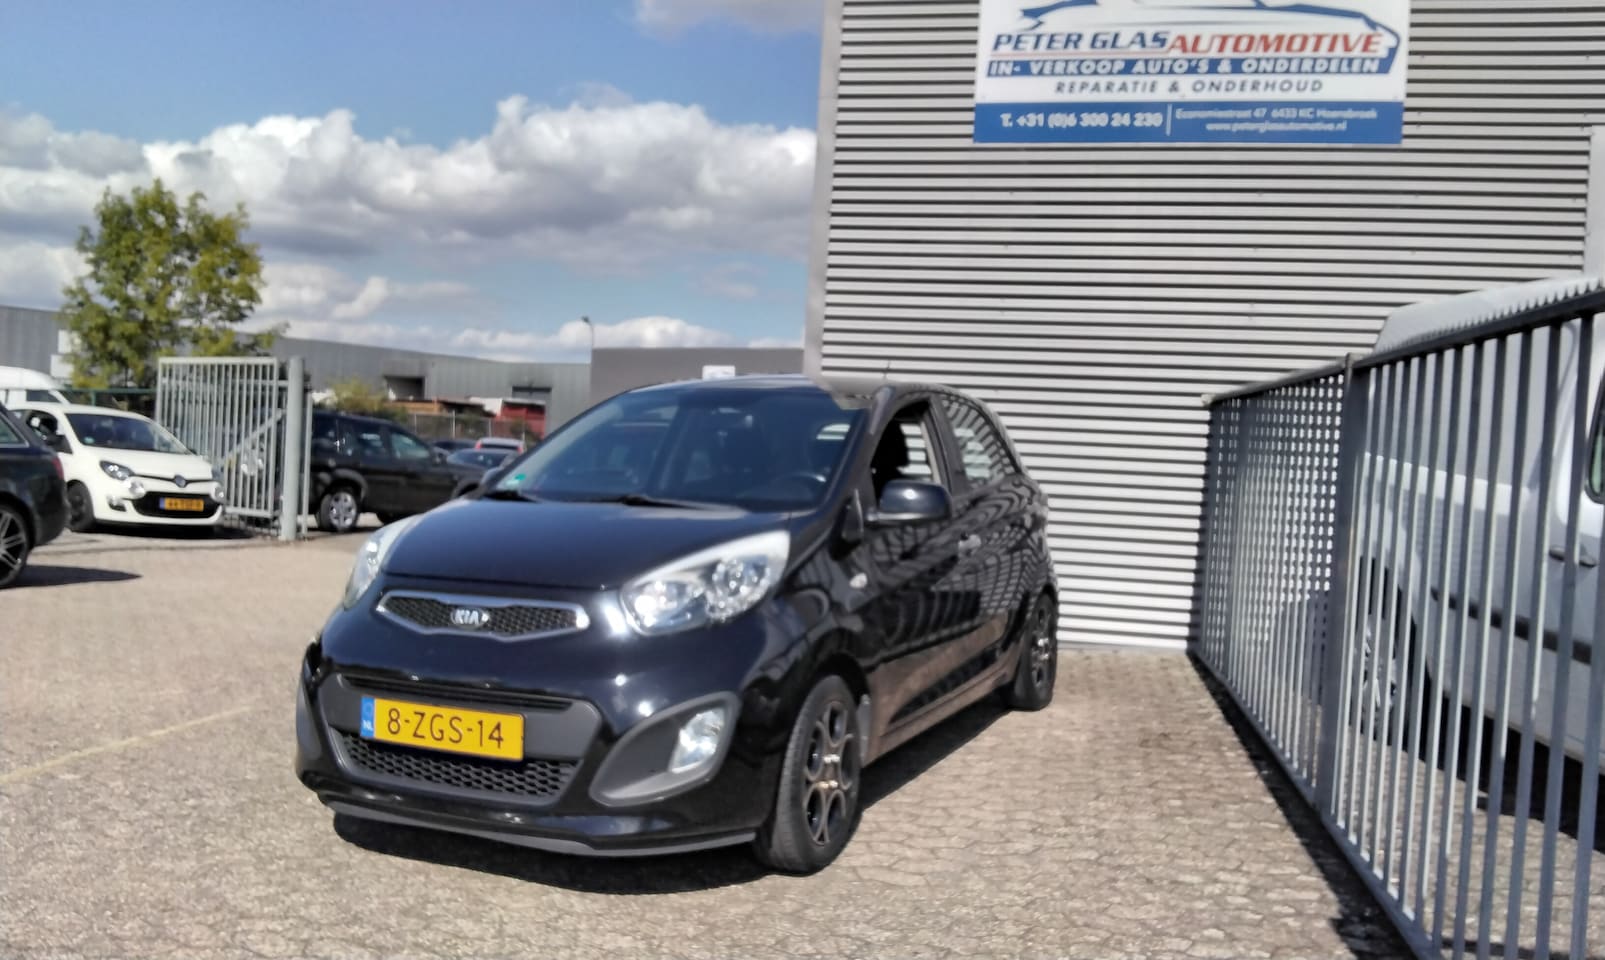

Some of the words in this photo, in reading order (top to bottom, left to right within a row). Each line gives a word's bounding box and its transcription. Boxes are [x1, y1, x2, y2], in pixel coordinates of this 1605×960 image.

[993, 32, 1083, 51] PETER
[990, 60, 1020, 75] IN-
[1030, 60, 1125, 75] VERKOOP
[1131, 59, 1209, 74] AUTO'S
[1217, 59, 1232, 74] &
[1241, 58, 1380, 73] ONDERDELEN
[1056, 80, 1158, 94] REPARATIE
[1168, 81, 1180, 93] &
[1192, 80, 1323, 93] ONDERHOUD
[1000, 113, 1013, 127] T.
[1016, 113, 1044, 127] +31
[1048, 112, 1077, 128] (0)6
[1080, 112, 1109, 127] 300
[1111, 112, 1131, 127] 24
[1133, 112, 1163, 127] 230
[454, 609, 480, 625] KIA
[362, 719, 374, 731] NL
[387, 707, 504, 749] 8-ZGS-14
